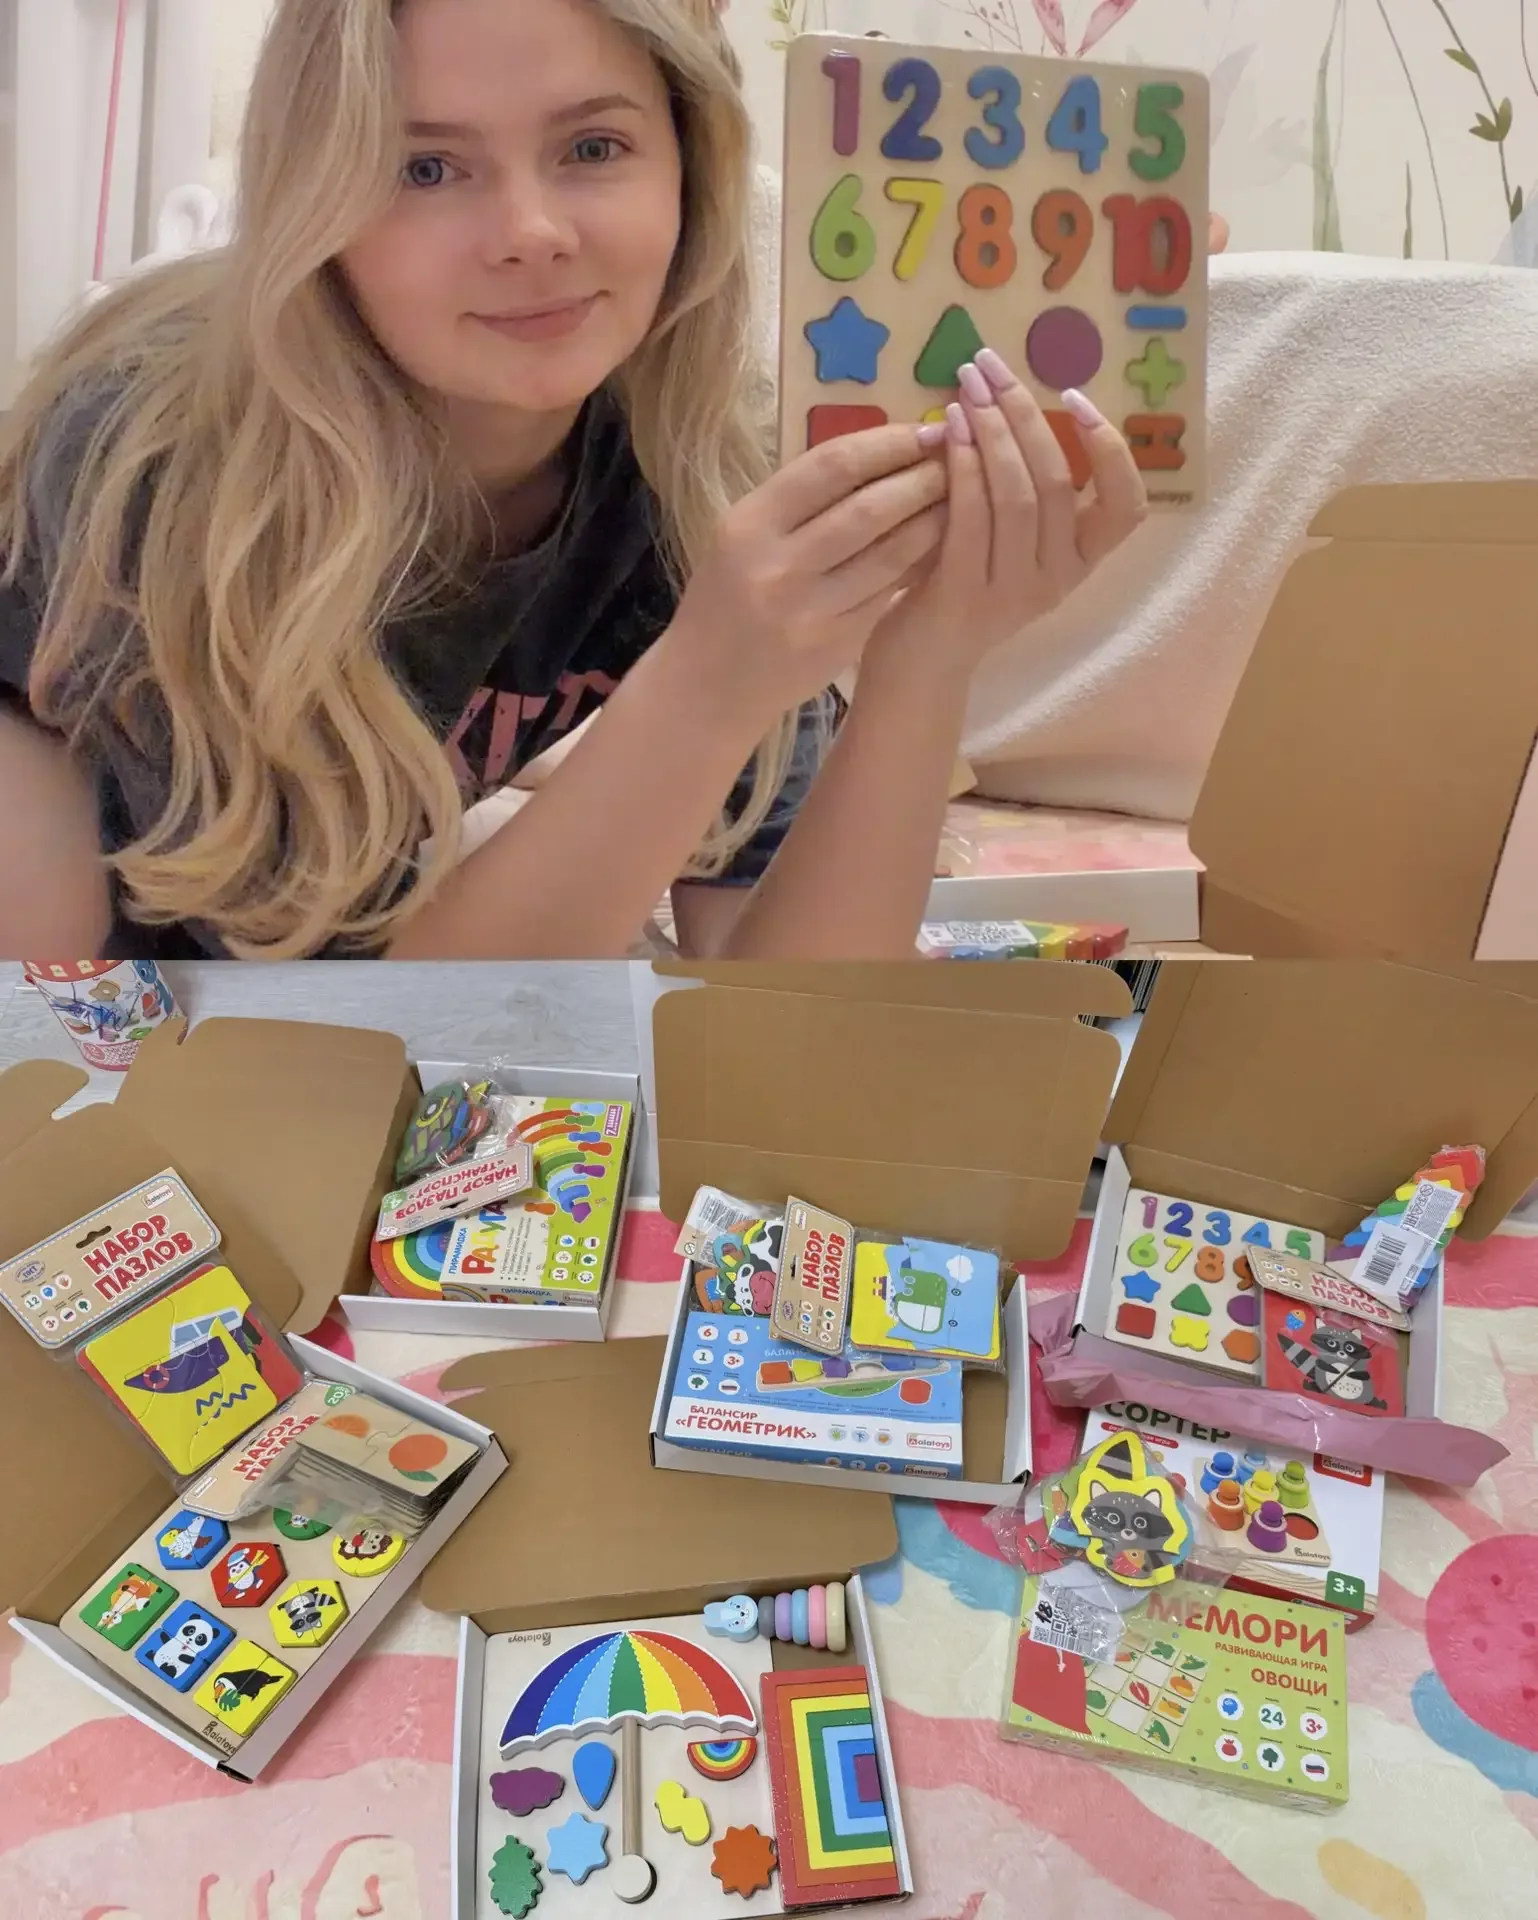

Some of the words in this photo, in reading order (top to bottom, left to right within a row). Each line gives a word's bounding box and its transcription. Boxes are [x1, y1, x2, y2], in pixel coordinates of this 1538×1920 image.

[821, 52, 861, 157] 1
[880, 58, 943, 162] 2
[963, 66, 1026, 170] 3
[1045, 75, 1109, 174] 4
[1127, 82, 1187, 181] 5
[809, 173, 877, 282] 6
[884, 177, 944, 282] 7
[953, 183, 1018, 289] 8
[1031, 188, 1094, 293] 9
[1101, 193, 1193, 297] 10
[462, 1164, 518, 1194] НАБОР
[395, 1188, 458, 1220] ПАЗЛОВ
[461, 1199, 508, 1274] РАДУГА
[1140, 1195, 1159, 1229] 1
[1163, 1202, 1194, 1237] 2
[1202, 1211, 1232, 1245] 3
[1241, 1221, 1272, 1248] 4
[1283, 1230, 1312, 1261] 5
[82, 1214, 168, 1275] НАБОР
[449, 1227, 467, 1275] ПИРАМИДКА
[802, 1230, 825, 1290] НАБОР
[1128, 1232, 1159, 1267] 6
[1162, 1236, 1194, 1273] 7
[1193, 1246, 1225, 1283] 8
[93, 1231, 194, 1301] ПАЗЛОВ
[822, 1232, 847, 1302] ПАЗЛОВ
[26, 1296, 40, 1308] 12
[1311, 1285, 1391, 1320] ПАЗЛОВ
[703, 1328, 712, 1337] 6
[733, 1332, 742, 1342] 1
[698, 1352, 707, 1362] 1
[328, 1390, 344, 1405] 20
[690, 1405, 758, 1420] БАЛАНСИР
[675, 1415, 817, 1440] «ГЕОМЕТРИК»
[232, 1416, 297, 1473] НАБОР
[1333, 1577, 1358, 1595] 3+
[1215, 1642, 1298, 1667] РАЗВИВАЮЩАЯ
[1300, 1660, 1328, 1673] ИГРА
[1251, 1667, 1328, 1697] ОВОЩИ
[1261, 1707, 1284, 1726] 24
[1306, 1718, 1323, 1734] 3+
